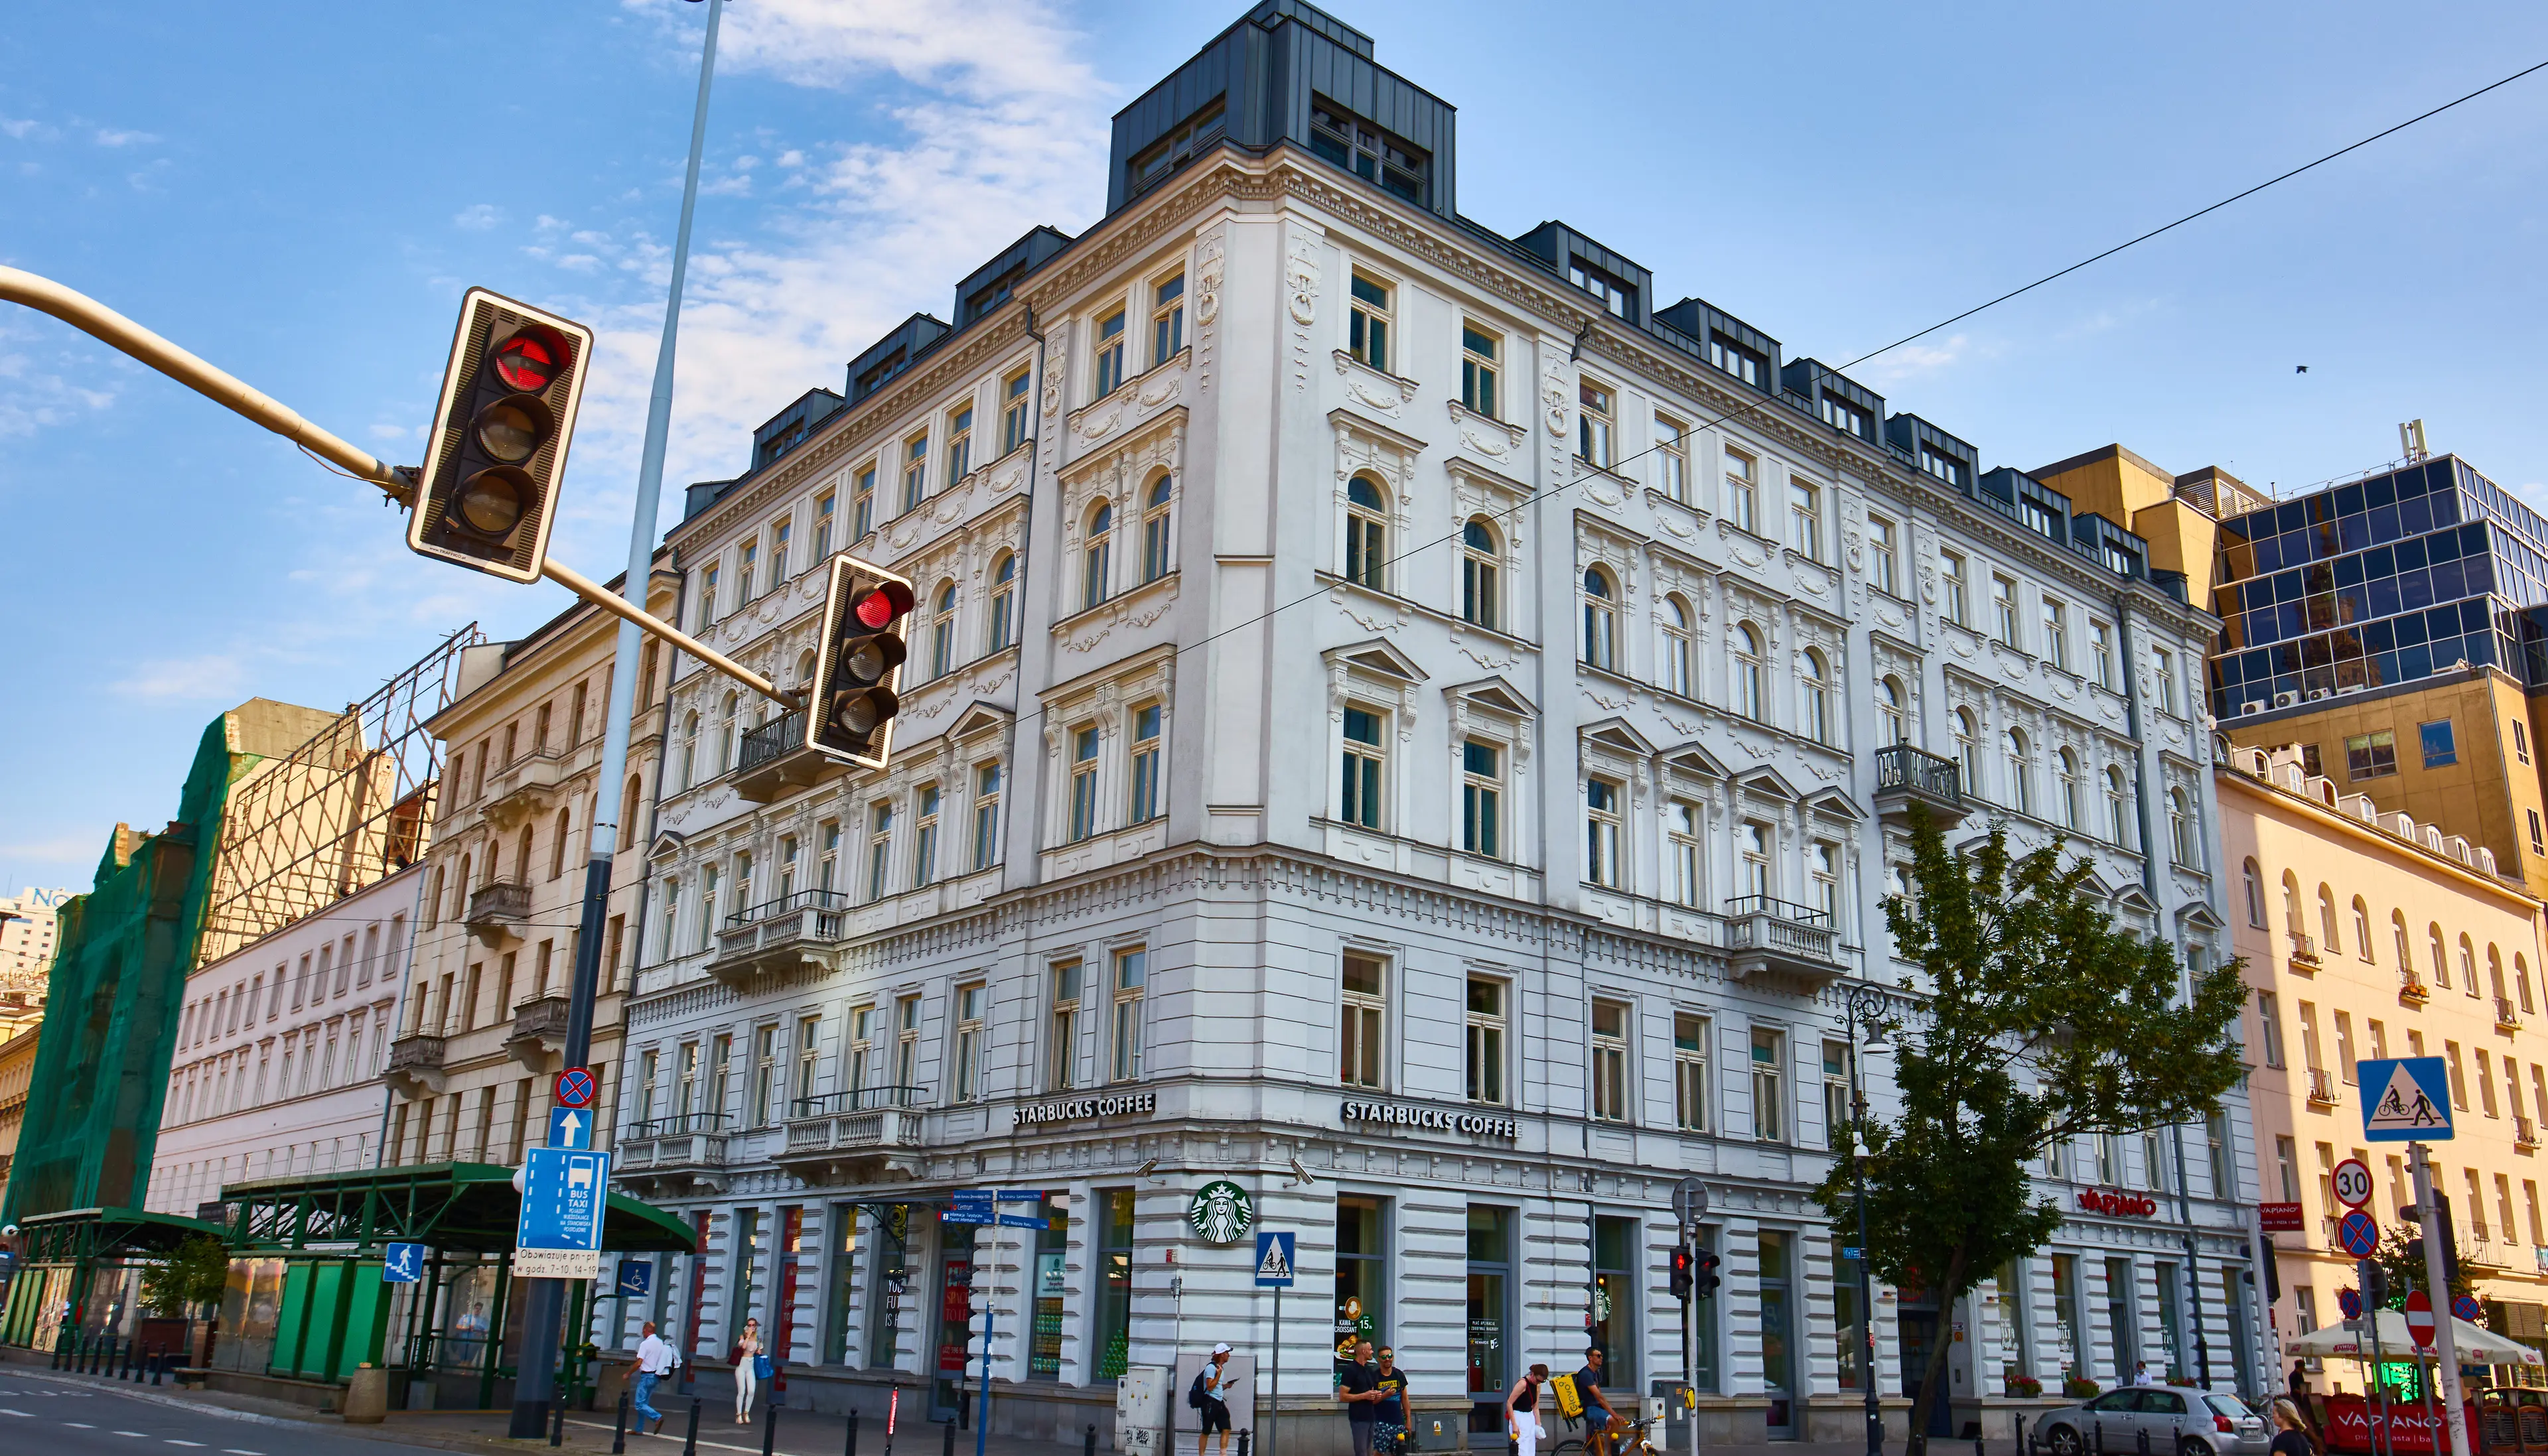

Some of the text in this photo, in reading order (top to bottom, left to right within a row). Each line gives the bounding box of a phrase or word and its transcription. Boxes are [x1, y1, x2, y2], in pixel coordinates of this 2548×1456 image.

[1012, 1094, 1153, 1126] STARBUCKS COFFEE
[1346, 1101, 1524, 1139] STARBUCKS COFFEE
[2338, 1171, 2367, 1196] 30
[570, 1189, 589, 1199] BUS
[567, 1199, 589, 1207] TAXI
[526, 1263, 547, 1275] godz.
[886, 1295, 899, 1308] FUT
[958, 1309, 967, 1320] LE
[1565, 1384, 1577, 1412] Glovo
[2338, 1411, 2442, 1429] VAPANO
